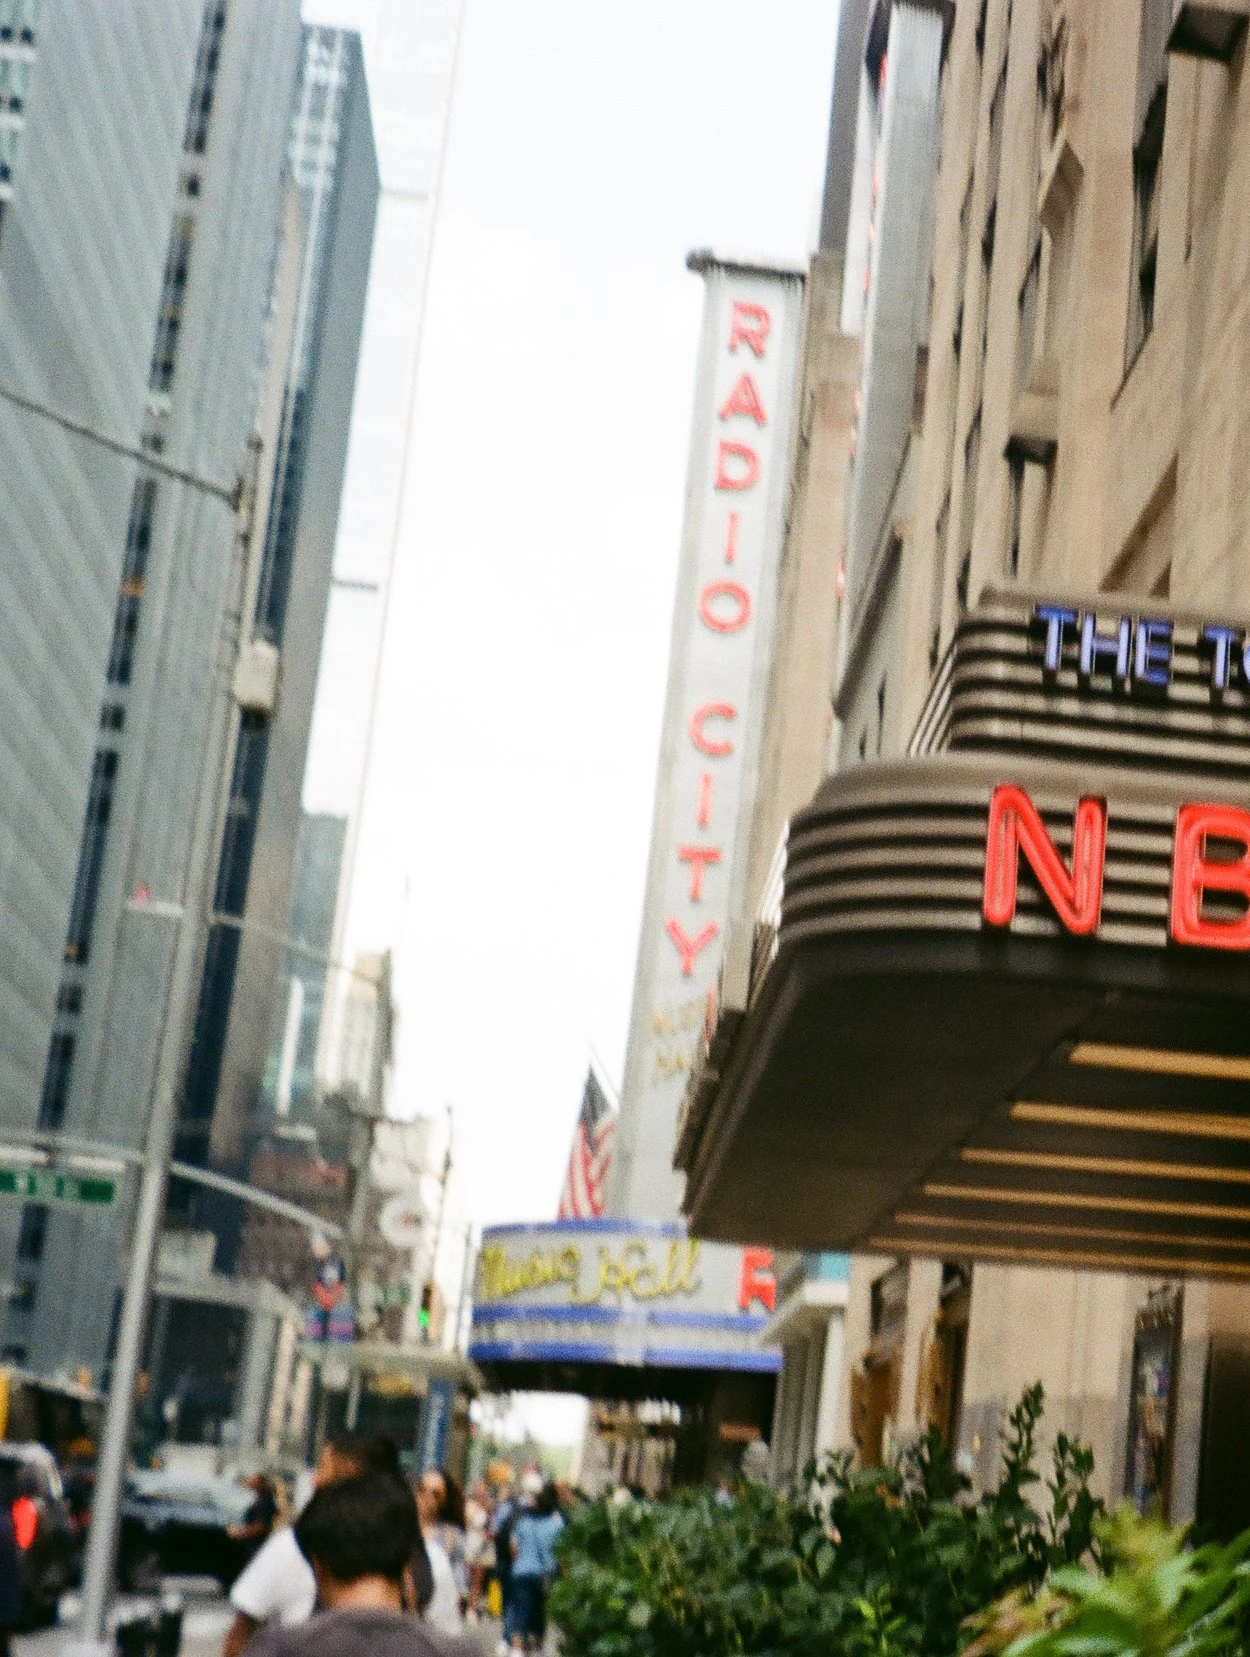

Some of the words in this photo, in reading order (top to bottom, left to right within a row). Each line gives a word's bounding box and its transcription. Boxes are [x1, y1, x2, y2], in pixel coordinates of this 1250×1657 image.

[697, 299, 773, 635] RADIO
[1034, 603, 1173, 687] THE
[663, 699, 738, 976] CITY
